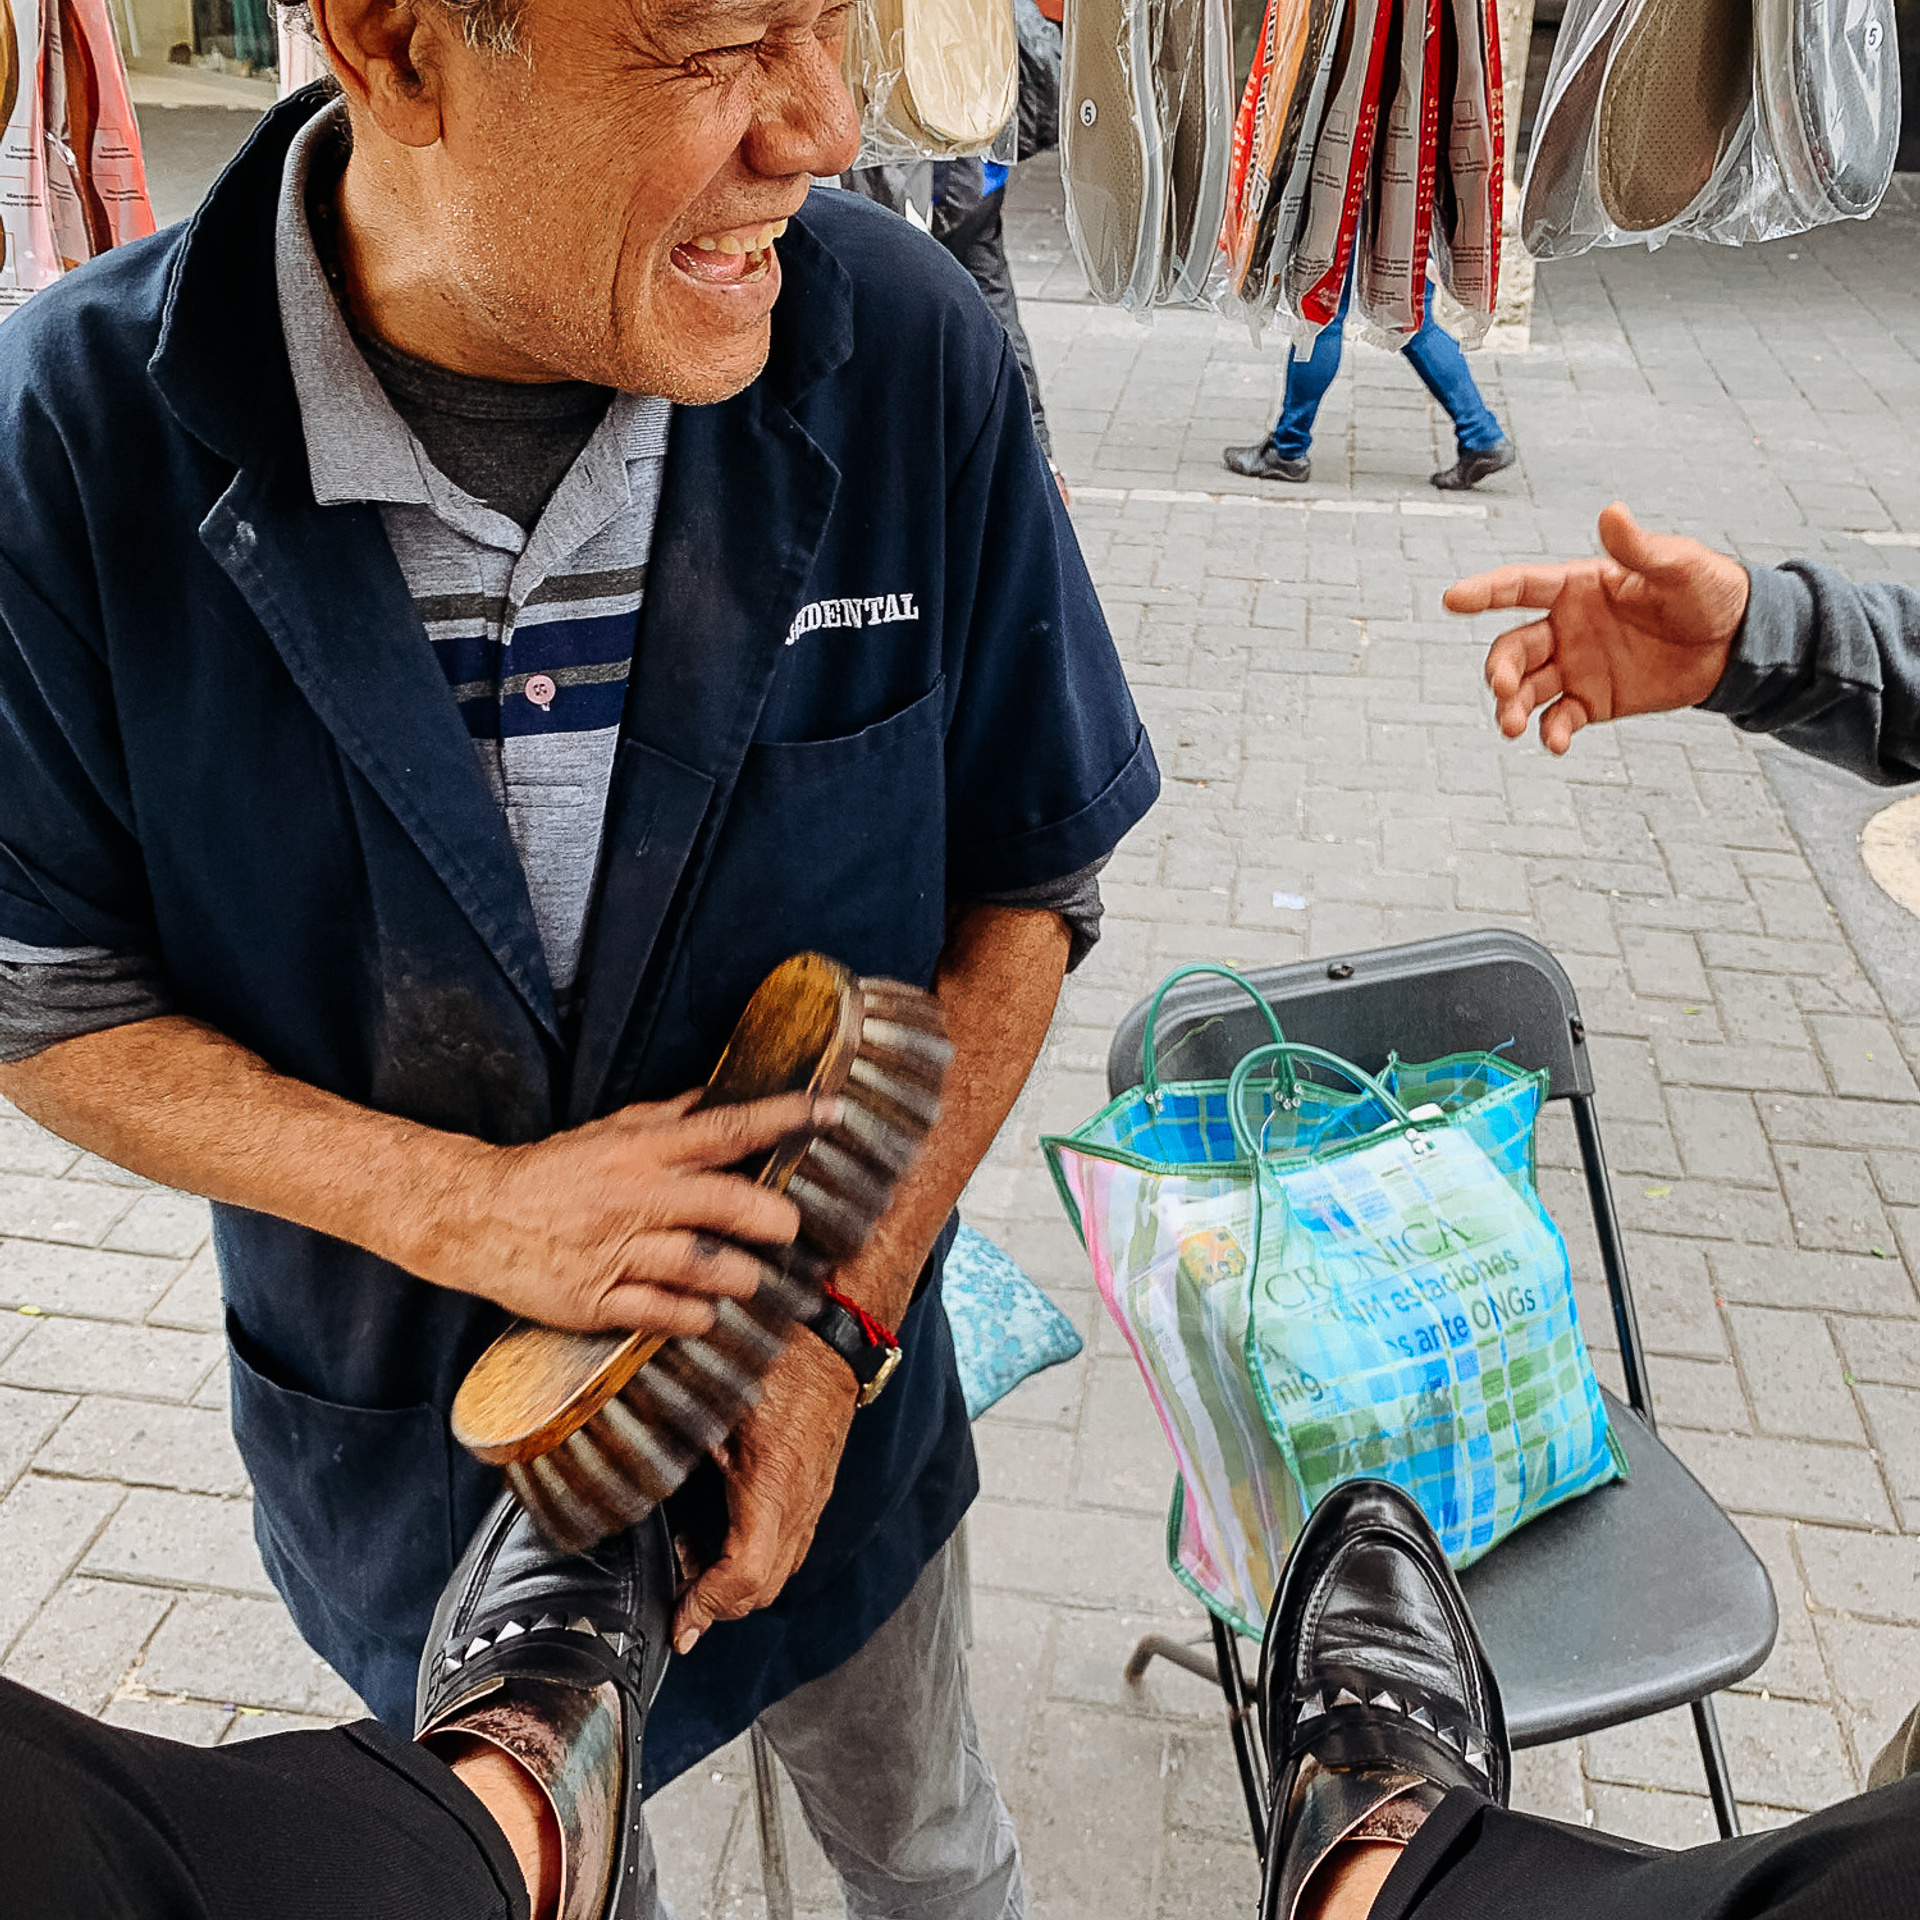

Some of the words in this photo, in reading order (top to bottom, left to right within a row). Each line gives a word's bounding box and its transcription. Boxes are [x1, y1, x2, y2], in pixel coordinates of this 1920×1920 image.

[1868, 27, 1878, 46] 5
[1084, 106, 1092, 124] 5
[1389, 1247, 1520, 1309] estaciones
[1415, 1312, 1470, 1356] ante
[1470, 1286, 1536, 1332] ONGs
